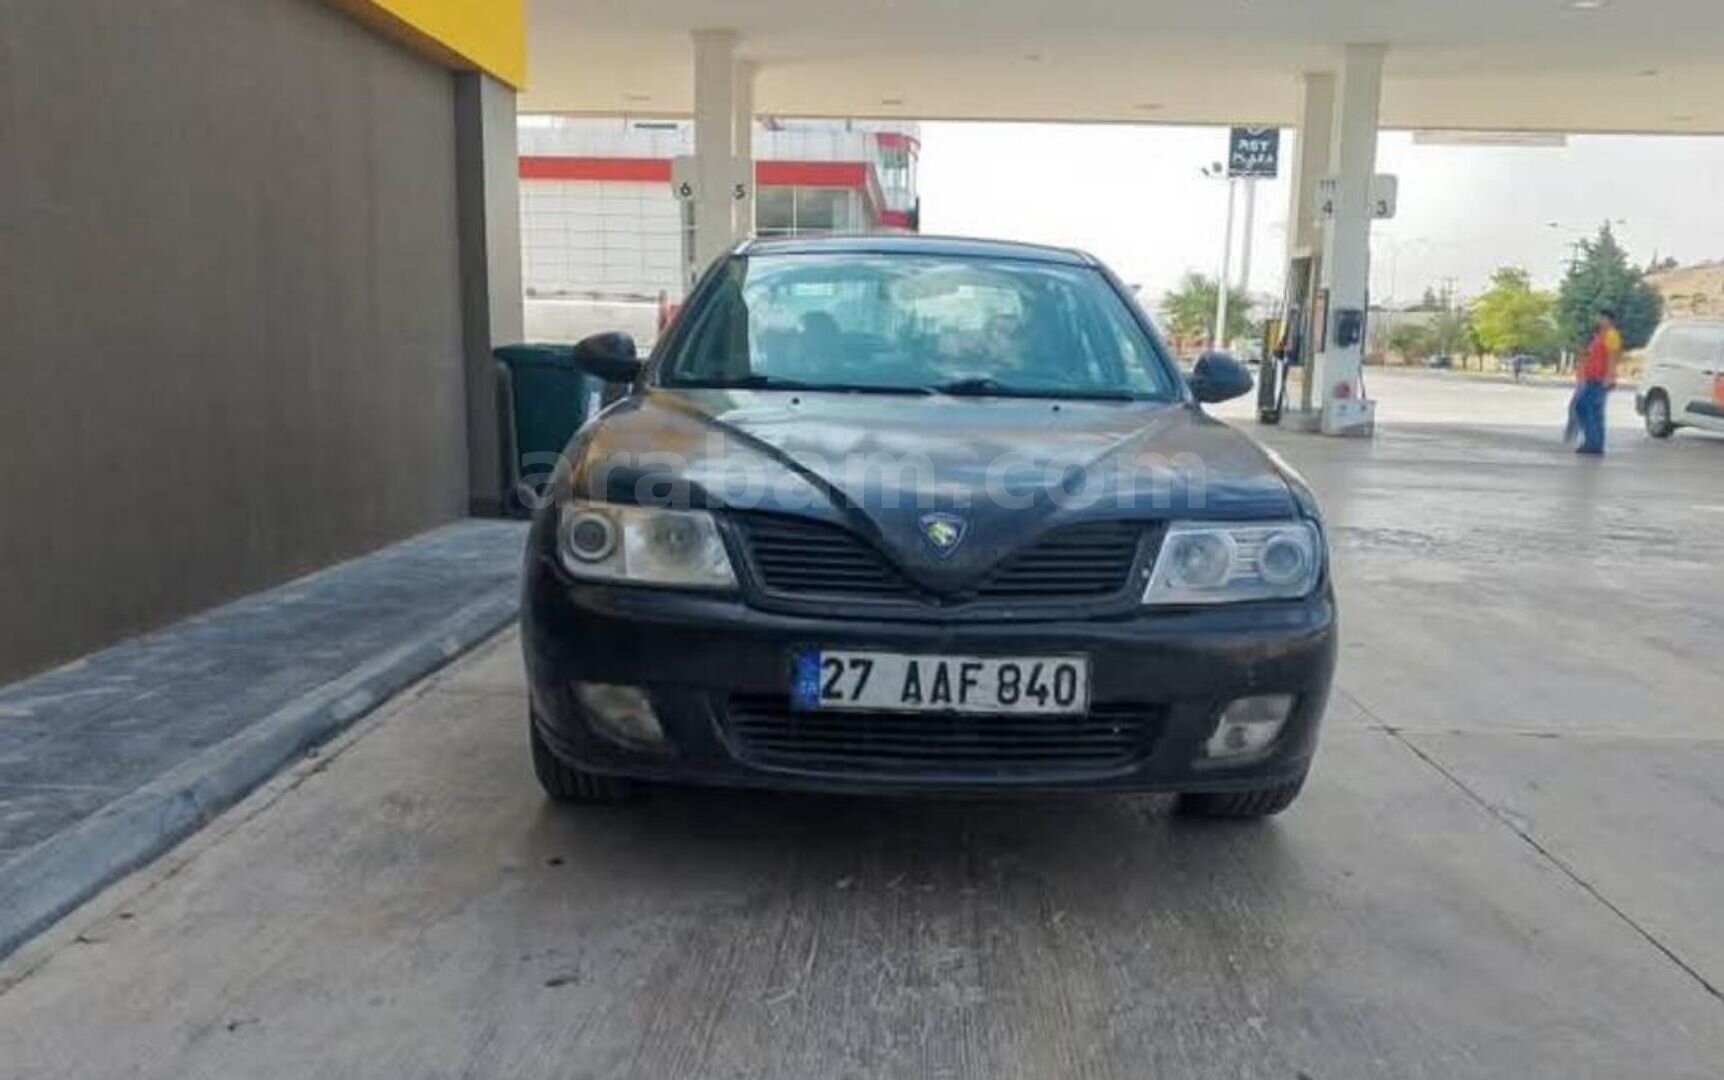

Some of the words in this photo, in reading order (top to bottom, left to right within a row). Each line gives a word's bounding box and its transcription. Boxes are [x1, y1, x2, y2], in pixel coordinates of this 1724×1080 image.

[680, 182, 692, 197] 6
[735, 184, 746, 200] 5
[1322, 200, 1333, 214] 4
[1376, 200, 1388, 215] 3
[820, 657, 874, 701] 27
[901, 660, 984, 704] AAF
[996, 663, 1078, 707] 840
